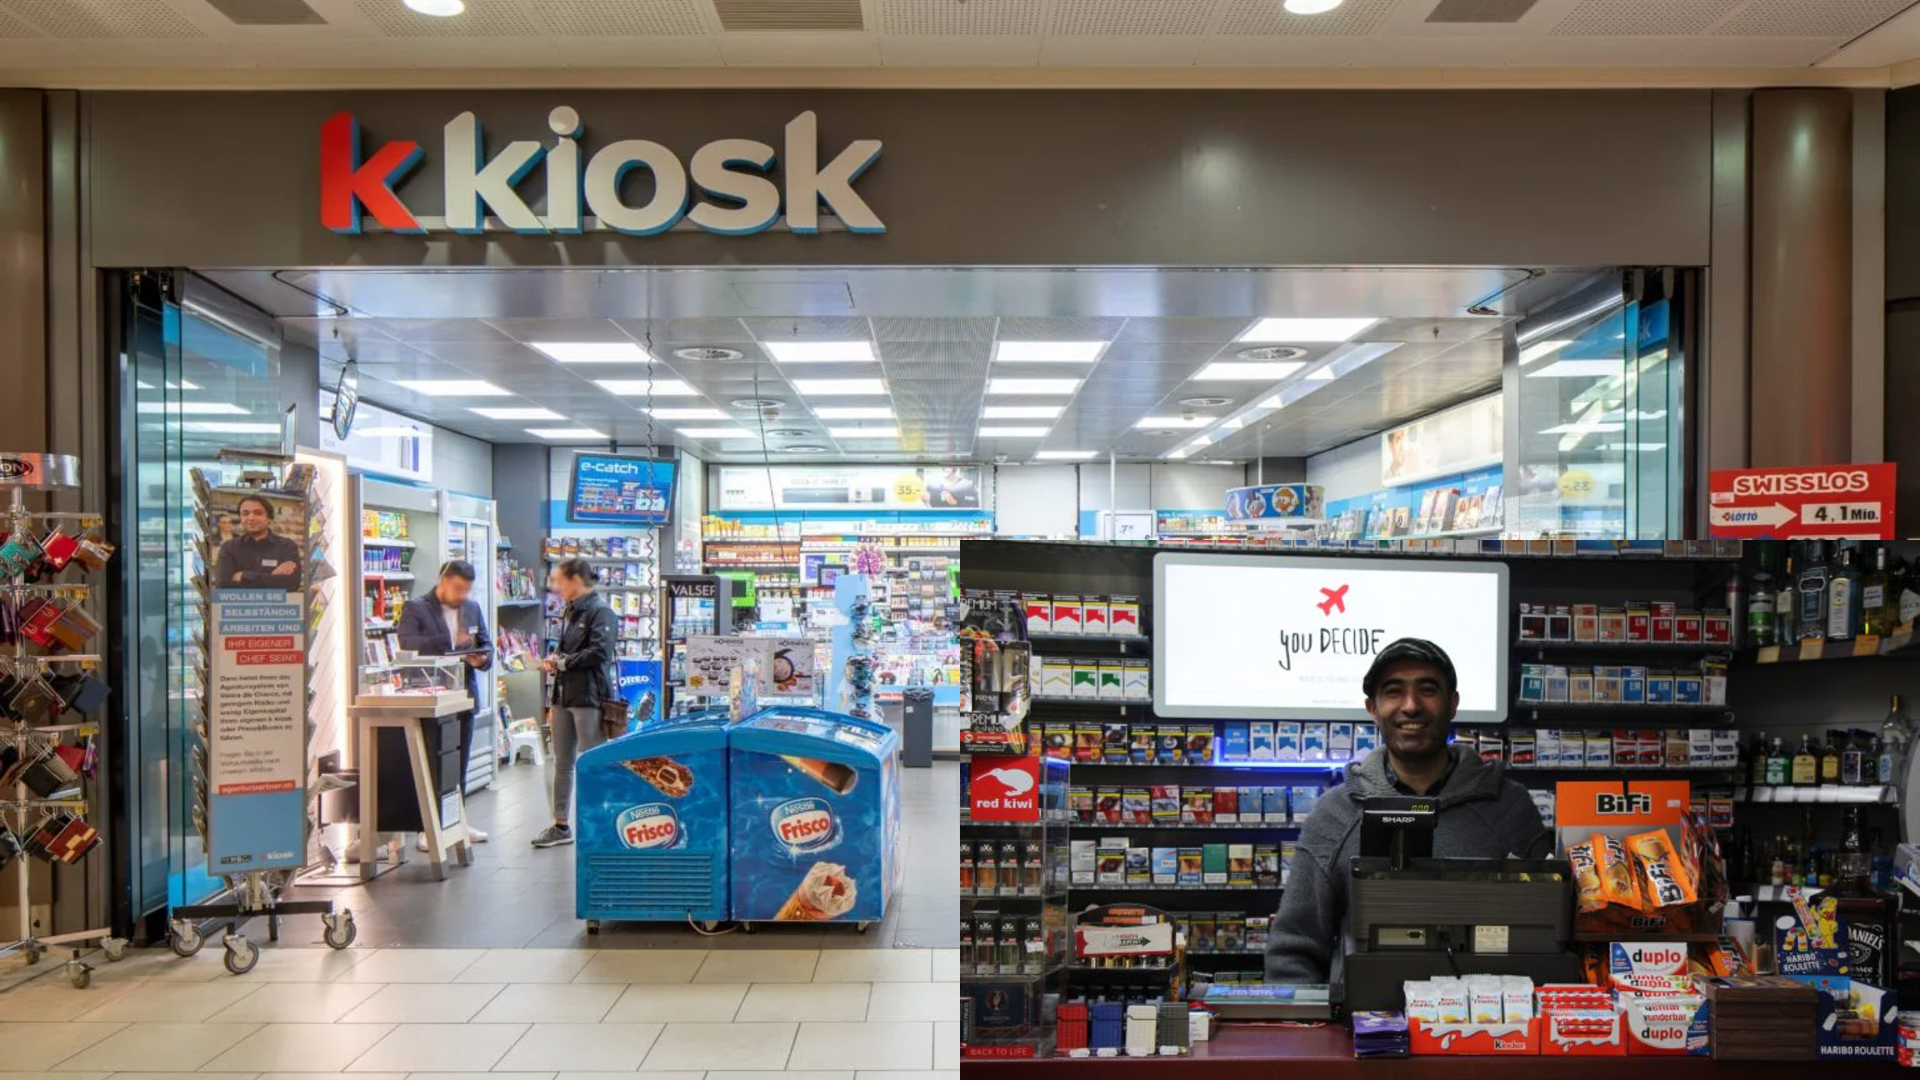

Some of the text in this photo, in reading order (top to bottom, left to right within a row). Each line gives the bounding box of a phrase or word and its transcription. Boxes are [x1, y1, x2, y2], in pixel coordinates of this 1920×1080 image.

[321, 106, 887, 235] k kiosk
[580, 461, 639, 475] e-catch
[1733, 471, 1869, 496] SWISSLOS
[1731, 512, 1758, 521] LOTTO
[1850, 508, 1879, 521] Mio.
[220, 592, 283, 601] WOLLEN SIE
[224, 607, 297, 617] SELBSTÄNDIG
[223, 624, 300, 633] ARBEITEN UND
[228, 639, 291, 649] IHR EIGENER
[1320, 627, 1385, 655] DECIDE
[240, 655, 266, 663] CHEF
[976, 798, 1033, 809] red kiwi
[1597, 793, 1652, 815] BiFi
[626, 822, 674, 844] Frisco
[780, 818, 829, 840] Frisco
[1632, 949, 1682, 965] duplo
[1786, 954, 1816, 963] HARIBO
[1783, 962, 1820, 972] ROULETTE
[1641, 1027, 1683, 1041] duplo
[970, 1048, 1027, 1056] BACK TO LIFE
[1820, 1046, 1894, 1056] HARIBO ROULETTE
